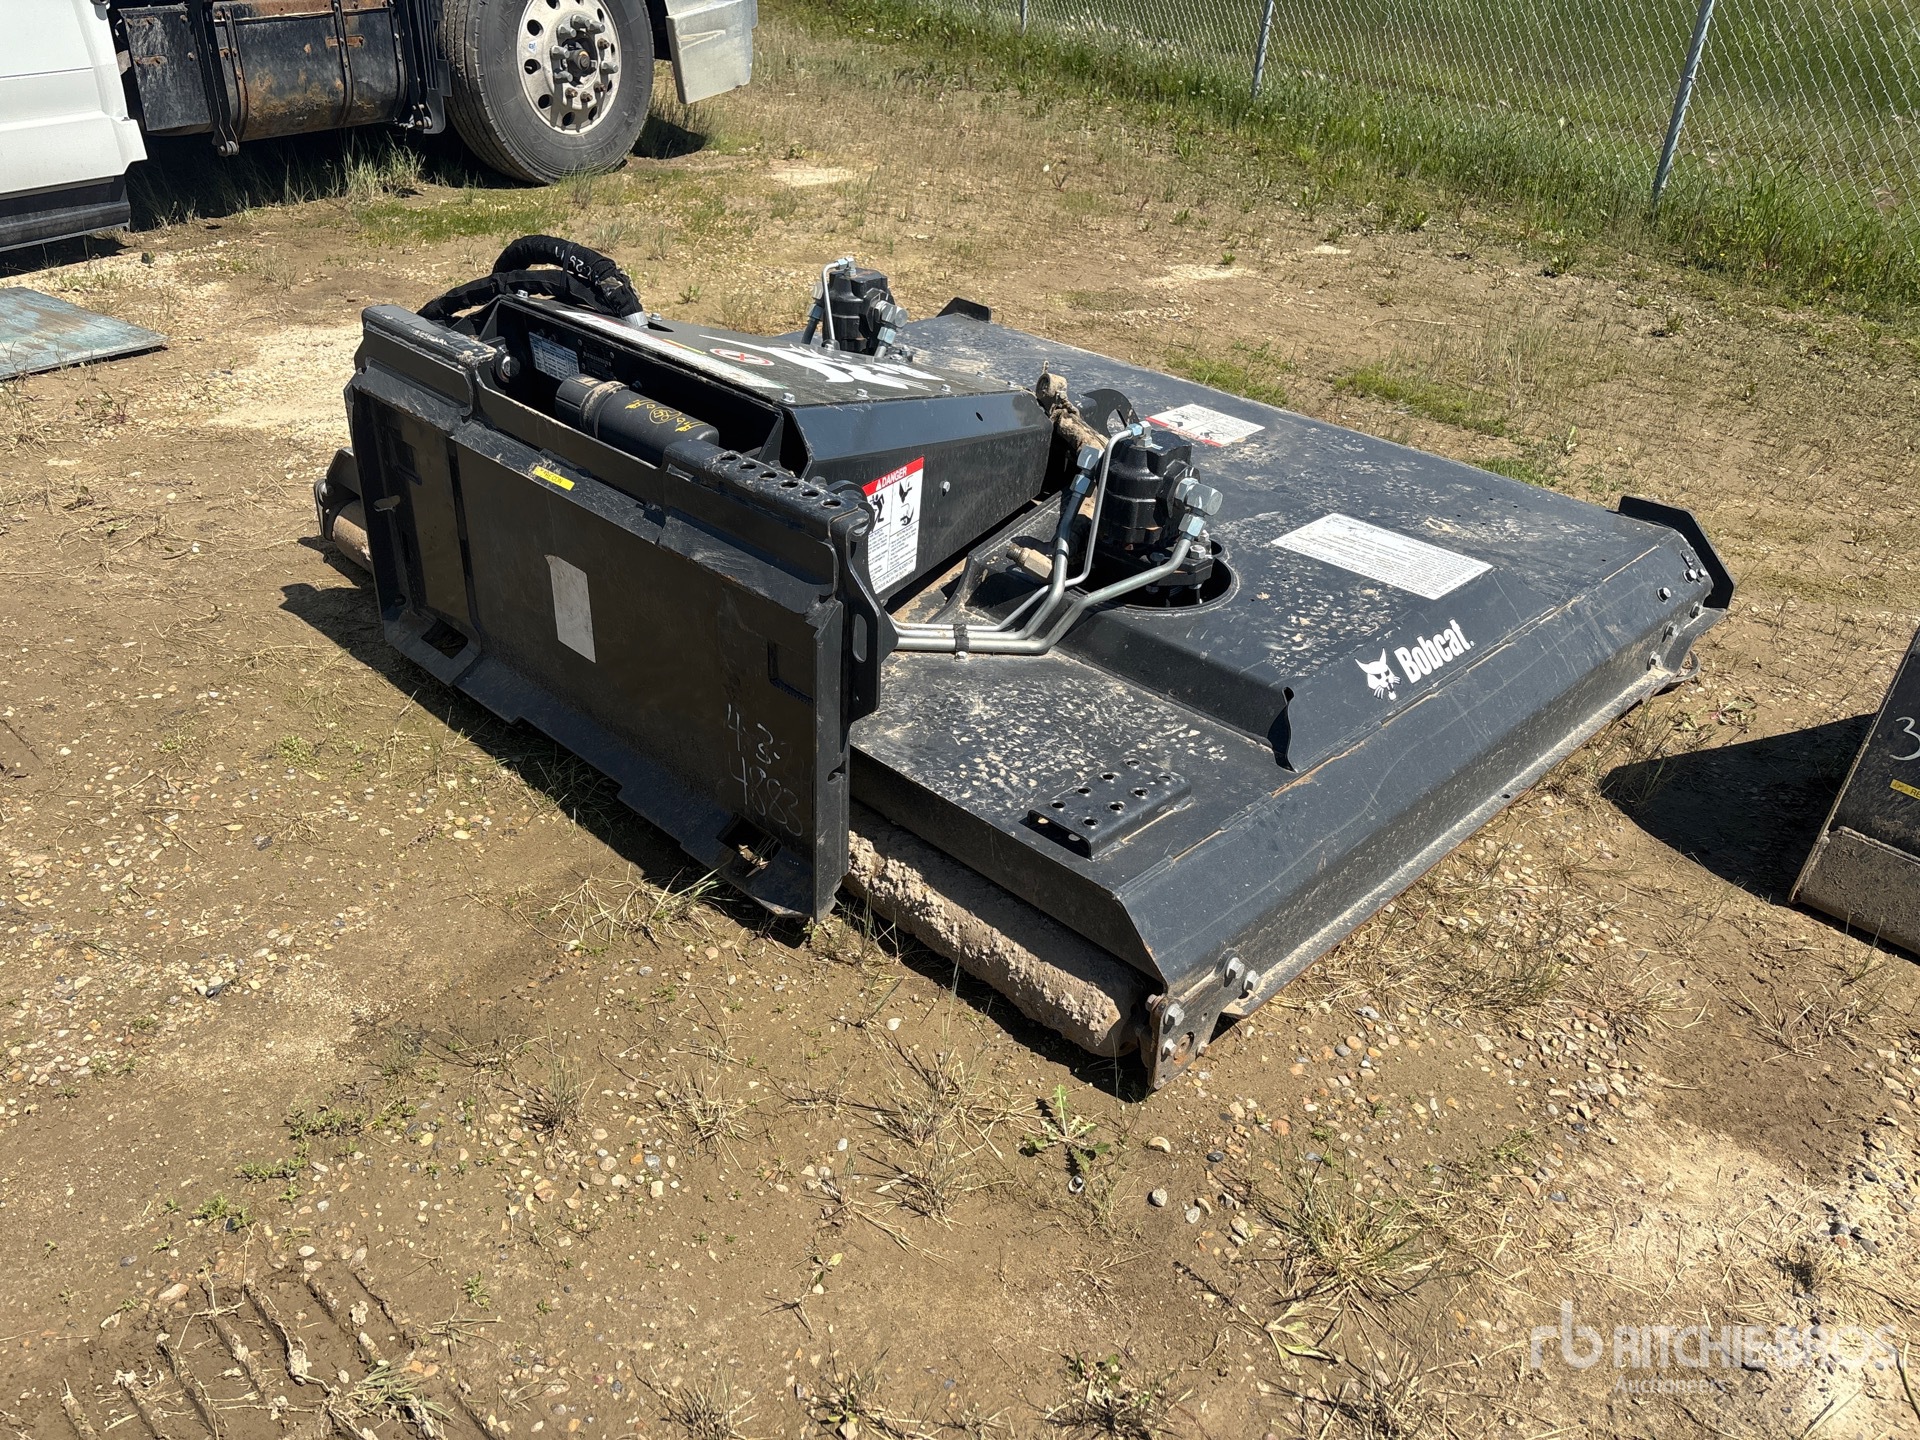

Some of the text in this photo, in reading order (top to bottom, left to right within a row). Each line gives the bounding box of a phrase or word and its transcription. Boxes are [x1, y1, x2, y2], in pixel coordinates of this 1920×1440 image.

[882, 467, 907, 487] DANGER
[1323, 557, 1359, 570] SERVICE
[1358, 569, 1395, 582] CUTTER
